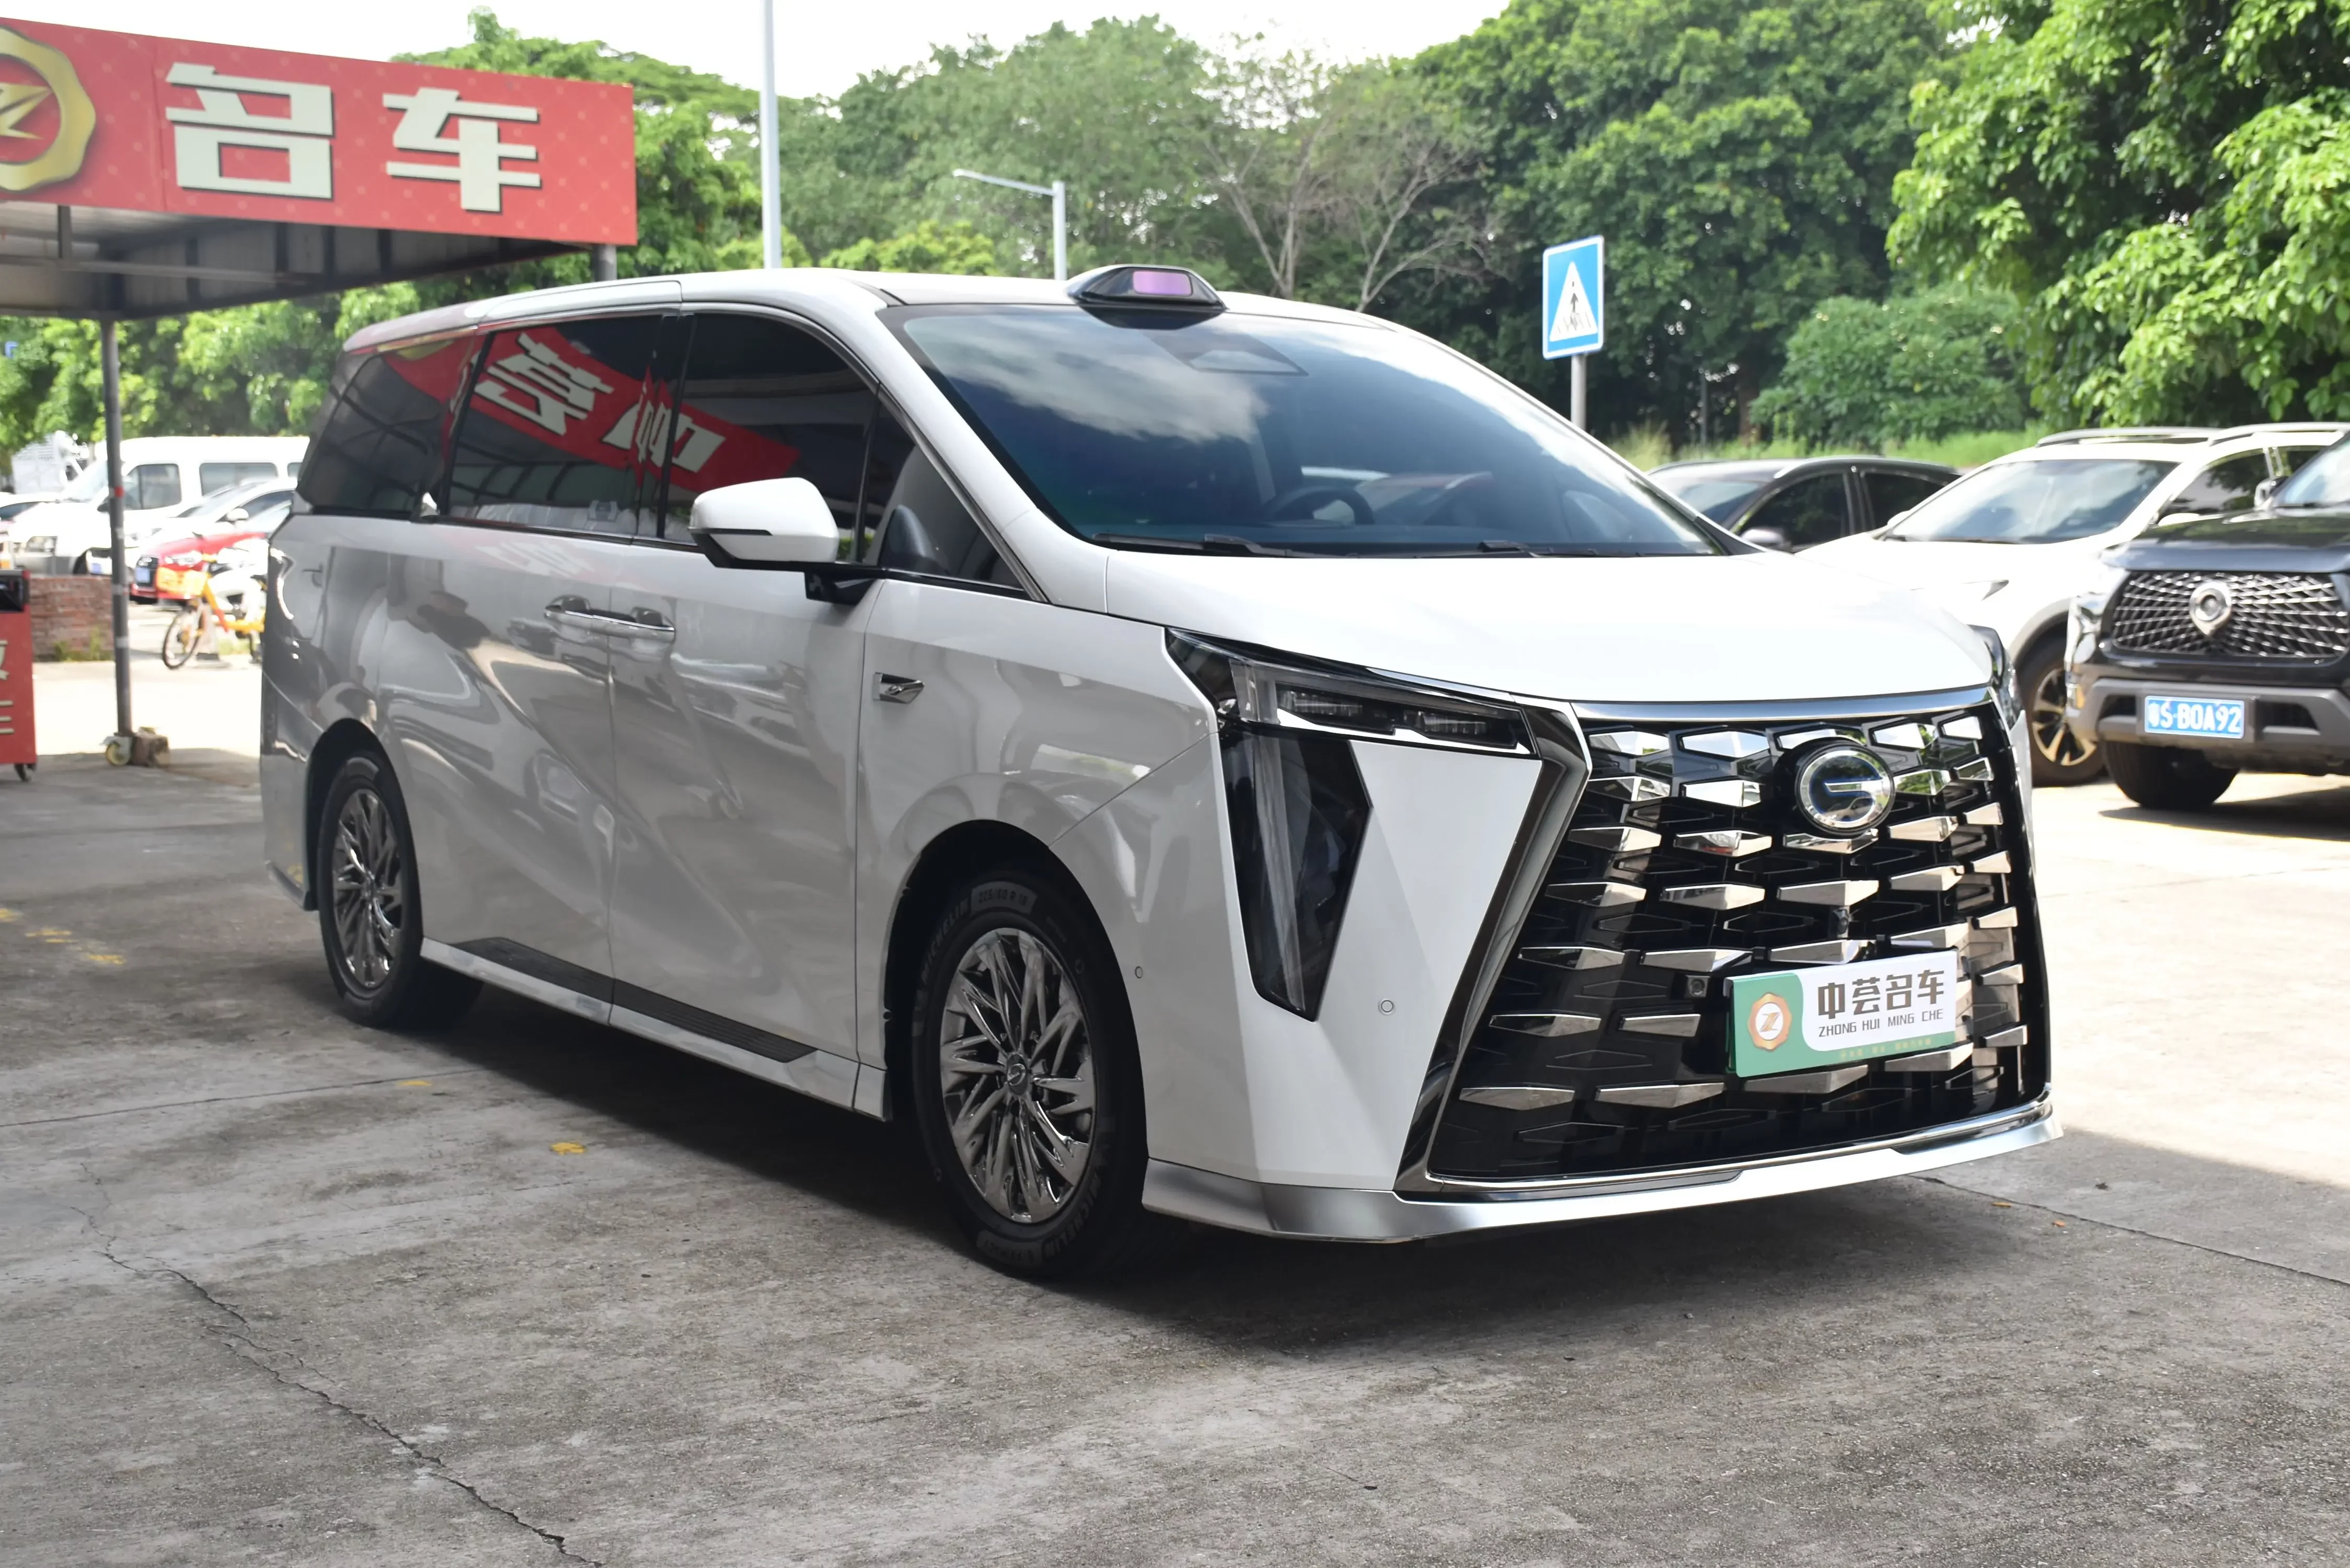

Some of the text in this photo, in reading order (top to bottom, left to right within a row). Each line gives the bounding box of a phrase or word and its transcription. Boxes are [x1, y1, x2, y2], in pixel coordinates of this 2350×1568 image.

[165, 61, 543, 214] 名车
[921, 898, 968, 986] MICHELIN
[1818, 970, 1944, 1019] 中荟名车
[1818, 1009, 1943, 1037] ZHONG HUI MING CHE
